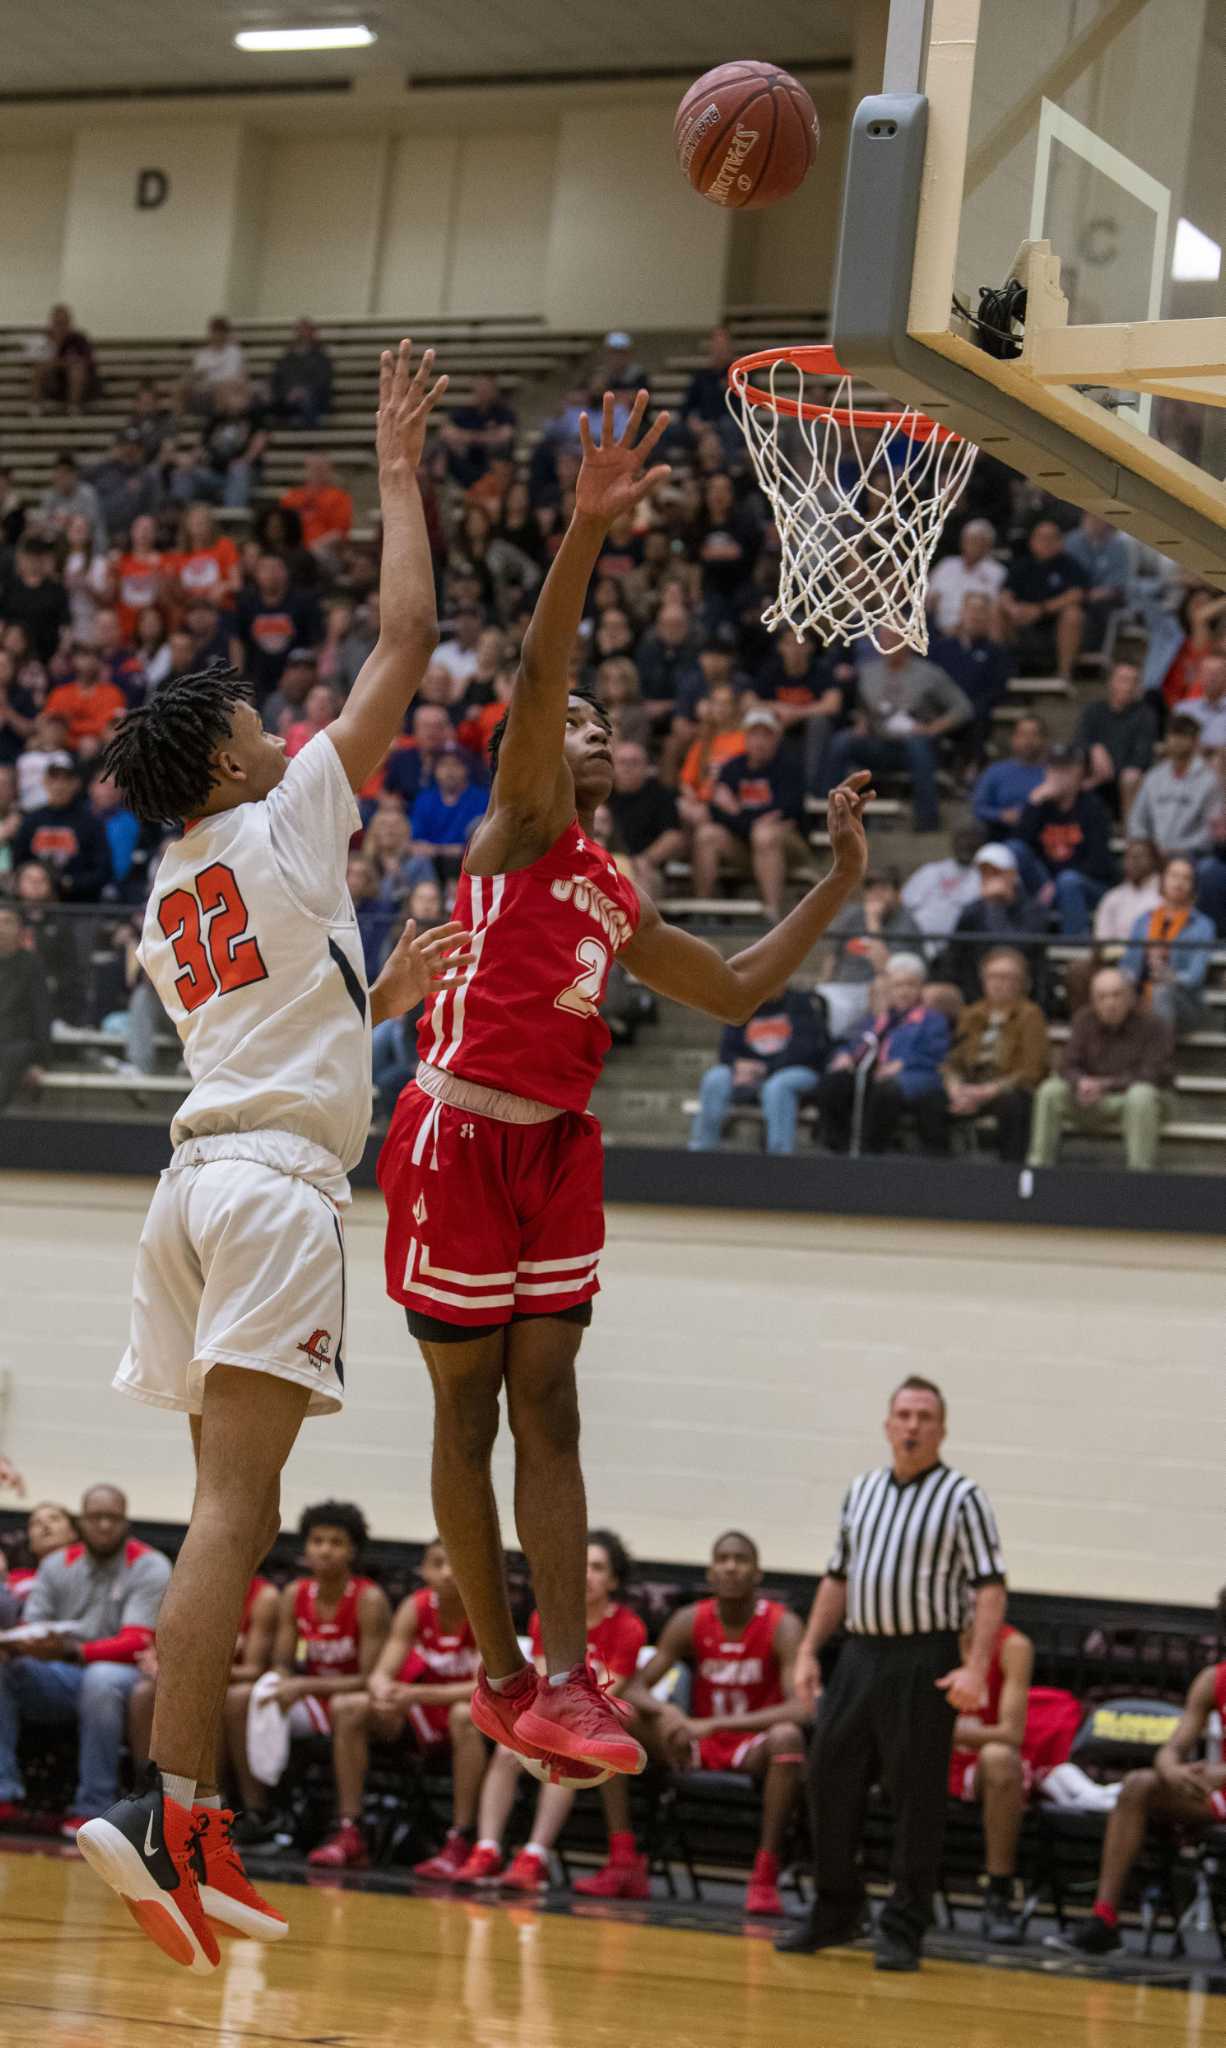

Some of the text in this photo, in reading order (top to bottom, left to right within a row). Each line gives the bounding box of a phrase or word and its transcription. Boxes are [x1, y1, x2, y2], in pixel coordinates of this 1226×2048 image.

[136, 168, 170, 209] D
[157, 861, 269, 1014] 32
[554, 935, 608, 1019] 2
